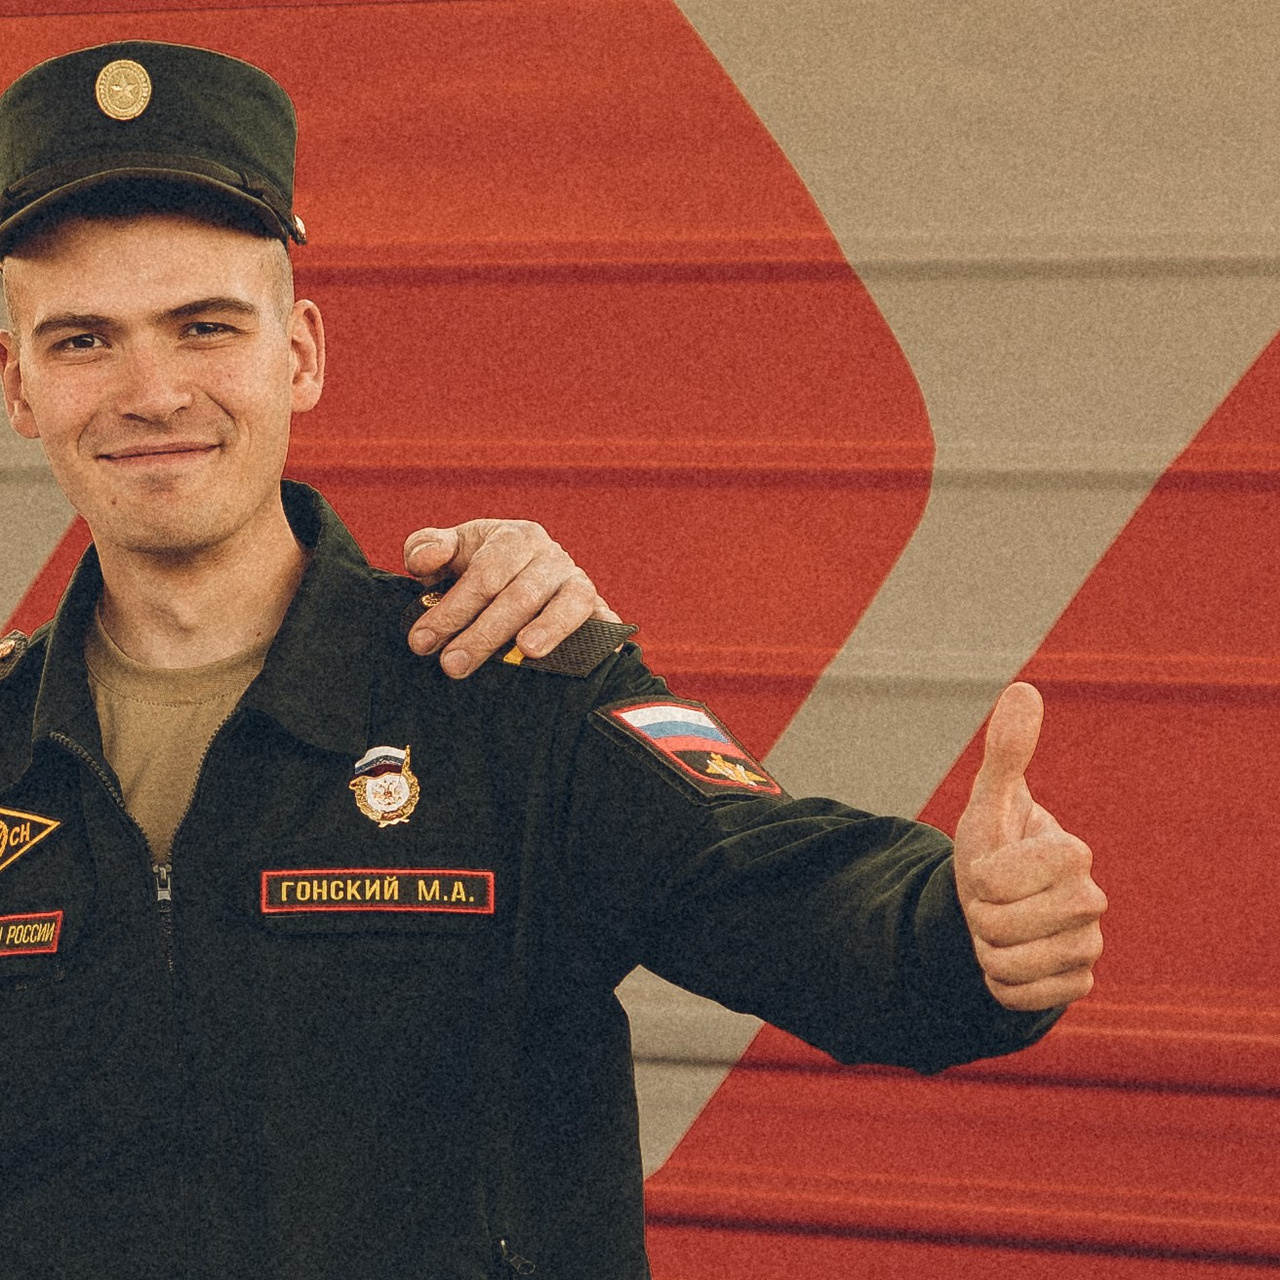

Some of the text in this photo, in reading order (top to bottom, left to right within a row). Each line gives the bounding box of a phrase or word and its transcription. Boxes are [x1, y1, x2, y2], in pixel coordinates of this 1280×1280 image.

[9, 822, 31, 847] СН
[281, 875, 475, 903] ГОНСКИЙ М.А.
[6, 922, 56, 945] РОССИИ
